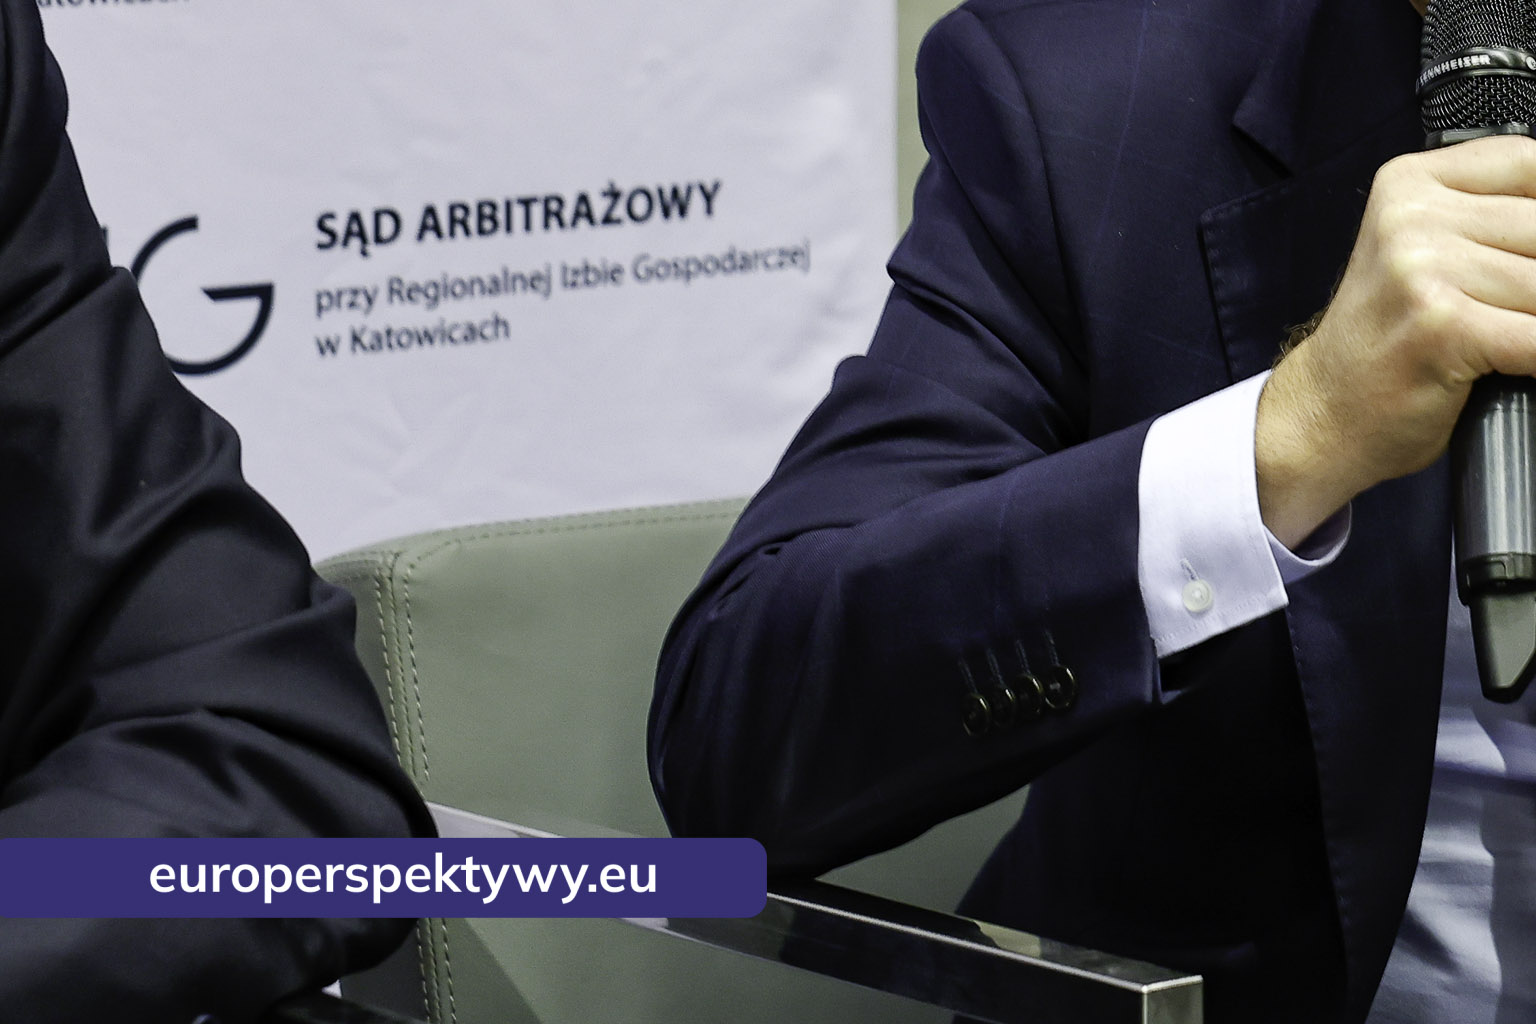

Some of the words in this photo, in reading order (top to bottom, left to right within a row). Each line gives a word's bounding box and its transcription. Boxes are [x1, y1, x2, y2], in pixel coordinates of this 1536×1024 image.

[1419, 54, 1491, 86] SENNHEISER
[315, 207, 404, 259] SĄD
[414, 180, 722, 245] ARBITRAŻOWY
[315, 287, 379, 319] przy
[387, 267, 552, 311] Regionalnej
[561, 259, 625, 291] Izbie
[632, 240, 811, 284] Gospodarczej
[315, 335, 342, 357] w
[350, 312, 511, 354] Katowicach
